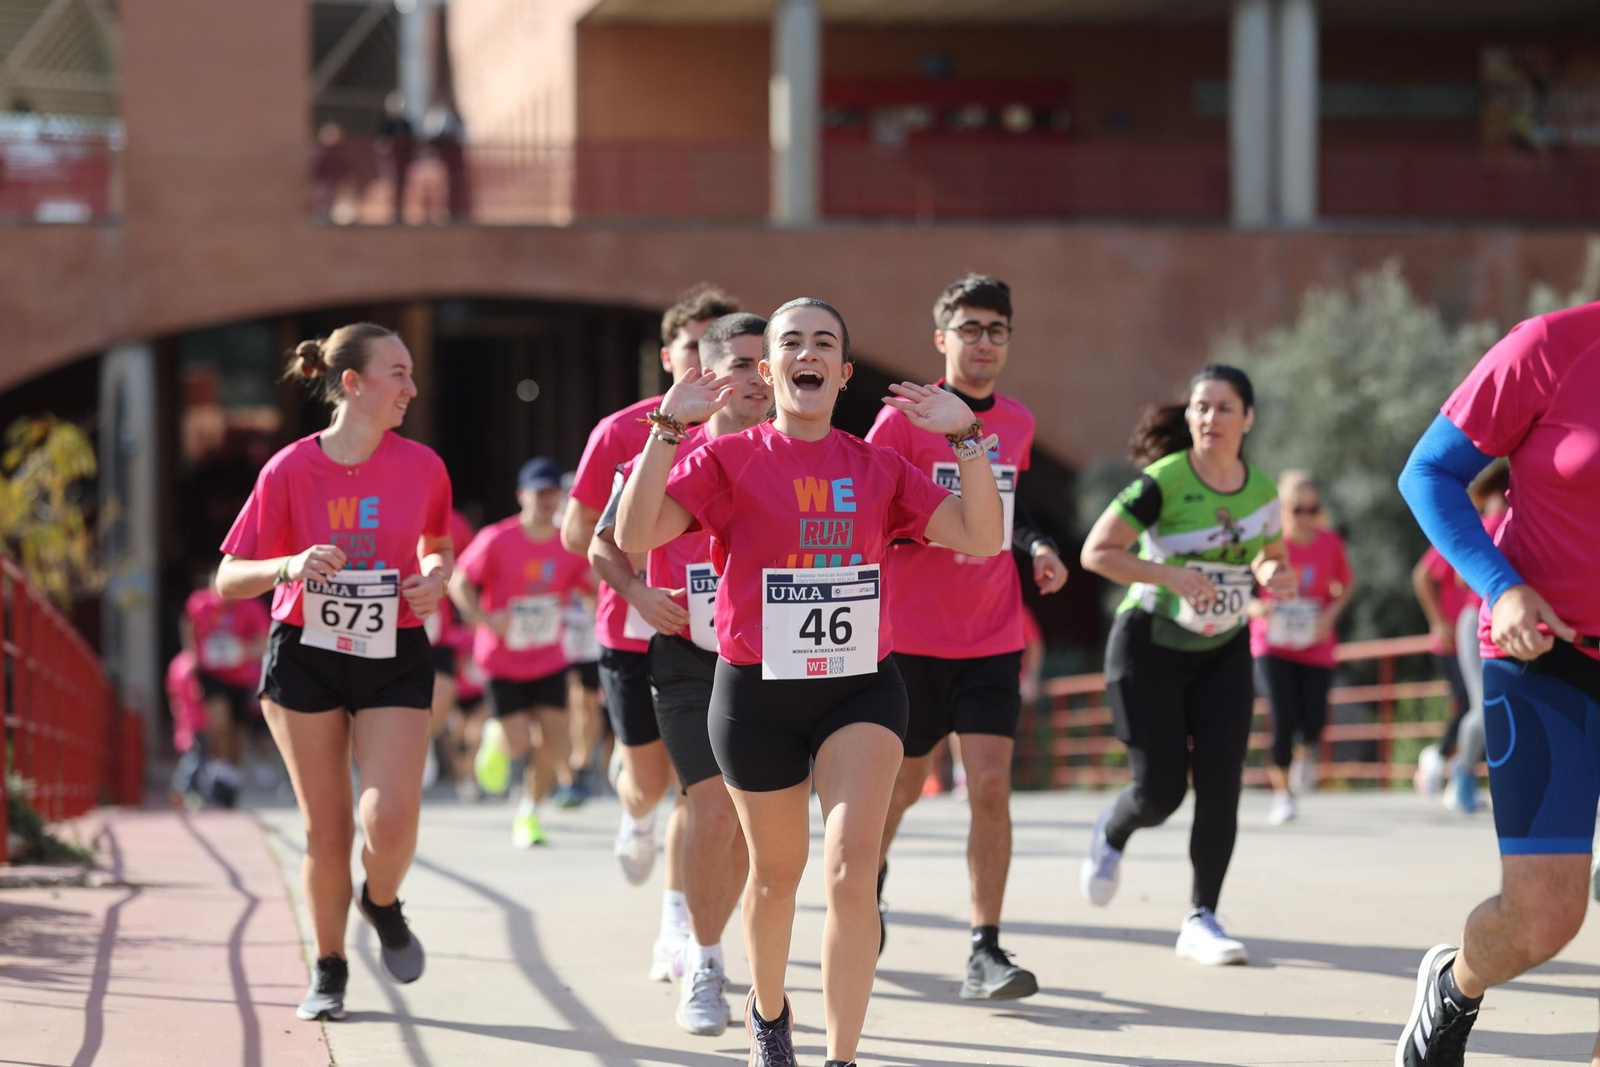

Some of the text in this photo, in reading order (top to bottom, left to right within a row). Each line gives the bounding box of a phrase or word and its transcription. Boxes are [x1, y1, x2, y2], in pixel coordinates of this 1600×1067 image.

[793, 476, 857, 512] WE
[327, 496, 379, 530] WE
[803, 520, 850, 547] RUN
[308, 579, 352, 597] UMA
[692, 578, 720, 592] UM
[769, 586, 824, 601] UMA
[321, 599, 384, 633] 673
[799, 606, 853, 646] 46
[807, 661, 828, 672] WE
[829, 667, 844, 675] RUN
